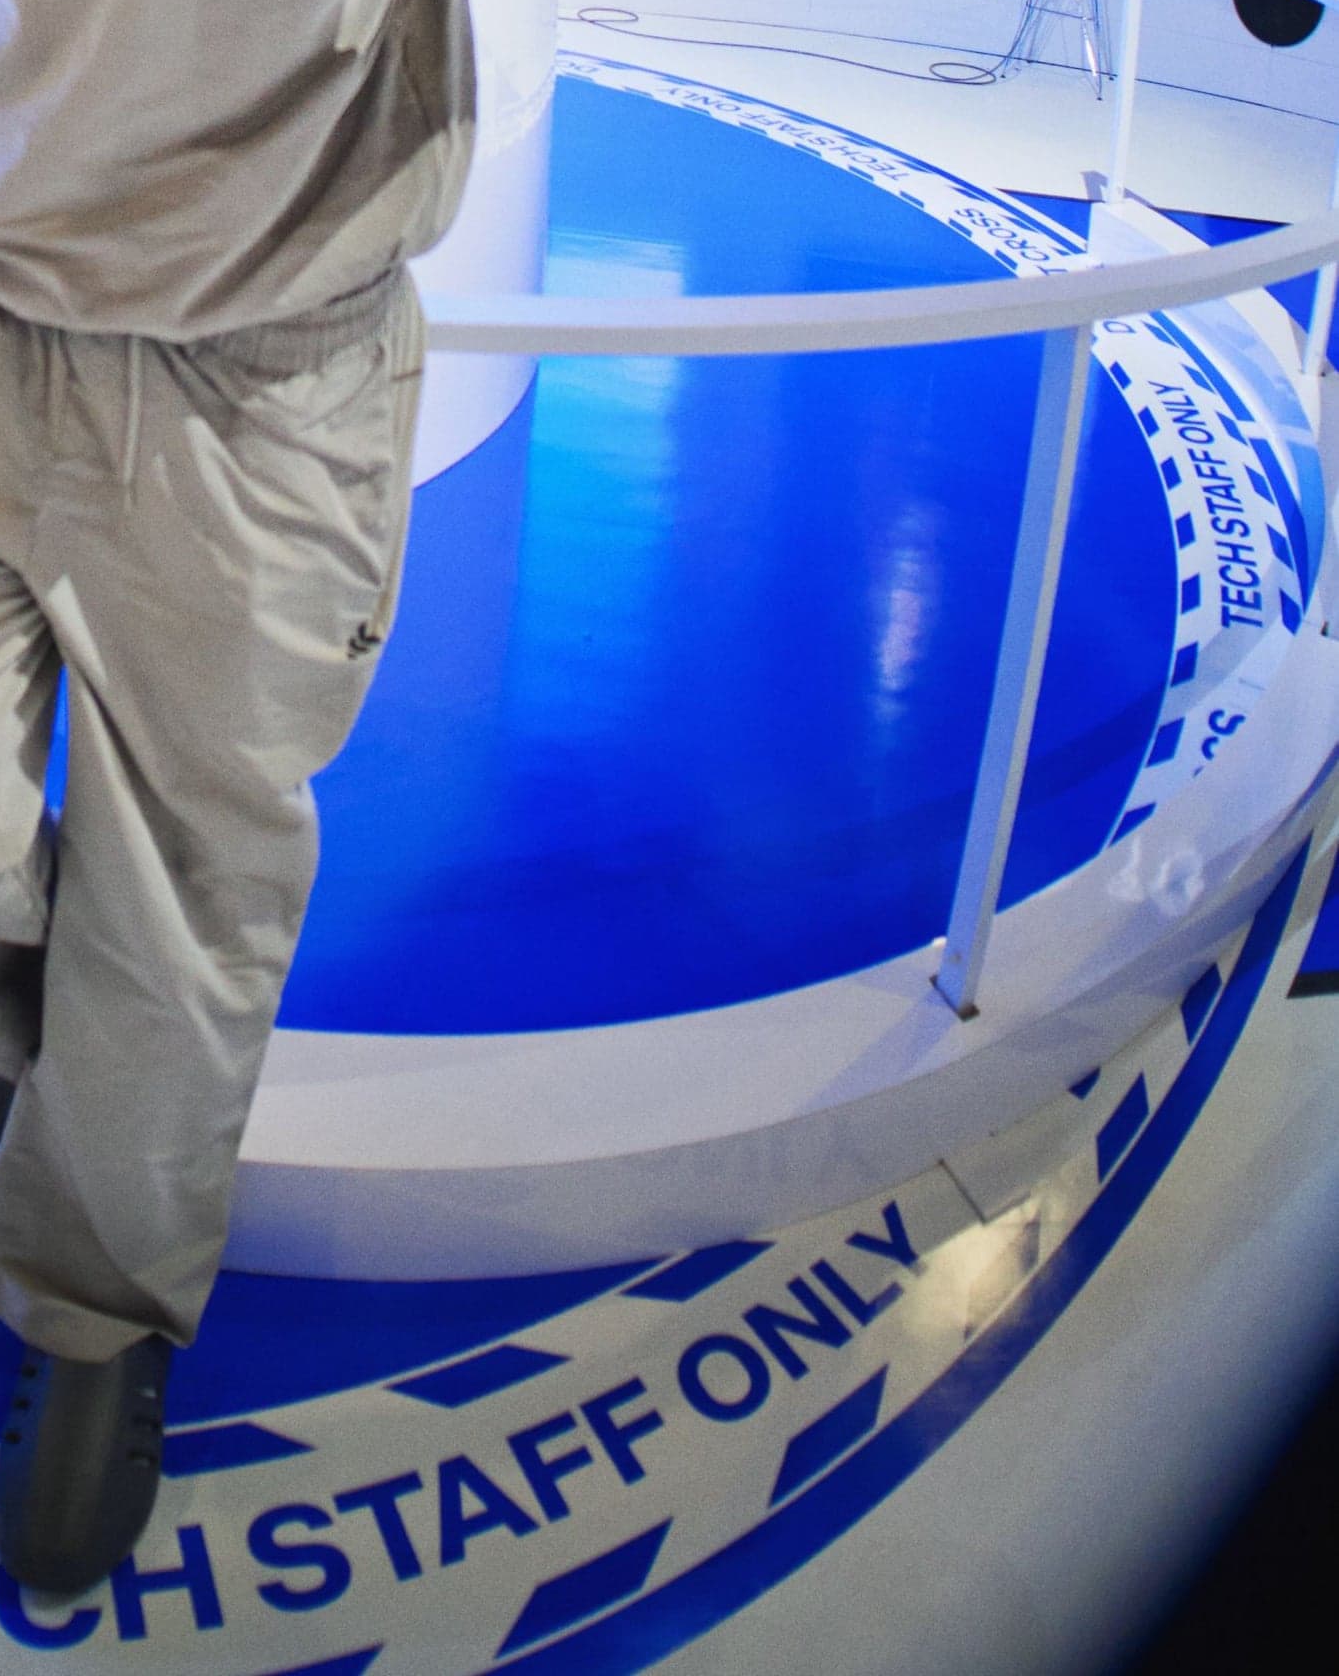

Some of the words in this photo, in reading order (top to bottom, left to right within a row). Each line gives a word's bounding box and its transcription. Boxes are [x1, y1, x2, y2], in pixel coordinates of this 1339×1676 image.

[736, 111, 836, 146] STAFF
[829, 145, 910, 181] TECH
[954, 208, 1050, 261] CROSS
[1148, 380, 1215, 445] ONLY
[1187, 447, 1251, 538] STAFF
[1214, 540, 1264, 628] TECH
[244, 1377, 669, 1612] STAFF
[676, 1201, 925, 1423] ONLY
